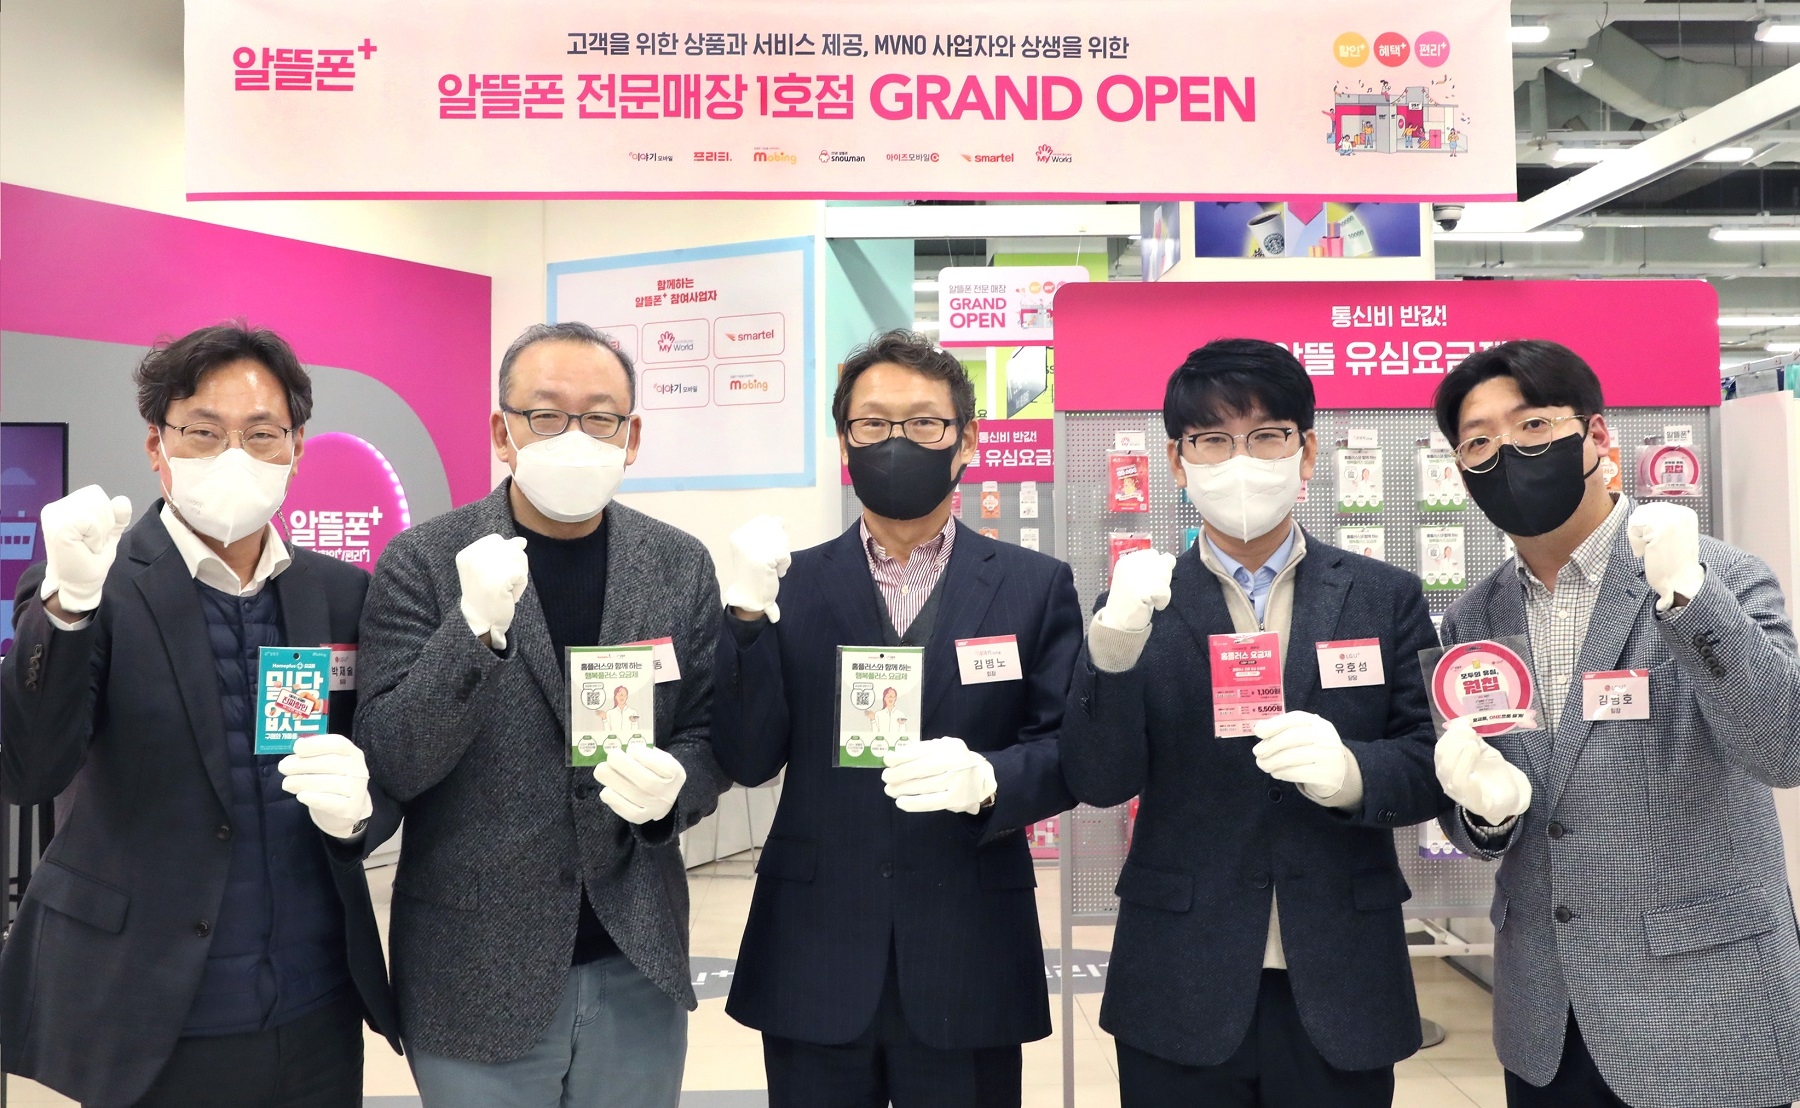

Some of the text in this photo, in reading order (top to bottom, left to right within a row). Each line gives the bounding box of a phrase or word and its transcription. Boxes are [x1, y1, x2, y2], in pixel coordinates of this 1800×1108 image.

[566, 32, 1130, 59] 고객을 위한 상품과 서비스 제공, MVNO 사업자와 상생을 위한
[437, 73, 1256, 123] 알뜰폰 전문매장 1호점 GRAND OPEN
[830, 154, 866, 163] snowman
[974, 153, 1014, 163] smartel
[1051, 155, 1072, 163] World
[657, 278, 694, 291] 함께하는
[973, 285, 989, 294] 전문
[990, 285, 1007, 294] 매장
[670, 290, 718, 305] 참여사업자
[949, 297, 1007, 311] GRAND
[949, 312, 1006, 329] OPEN
[1330, 303, 1448, 328] 통신비 반값!
[737, 329, 775, 342] smartel
[673, 342, 694, 352] World
[978, 430, 1038, 444] 통신비 반값!
[1335, 661, 1368, 674] 유호성
[1462, 676, 1500, 696] 원칩
